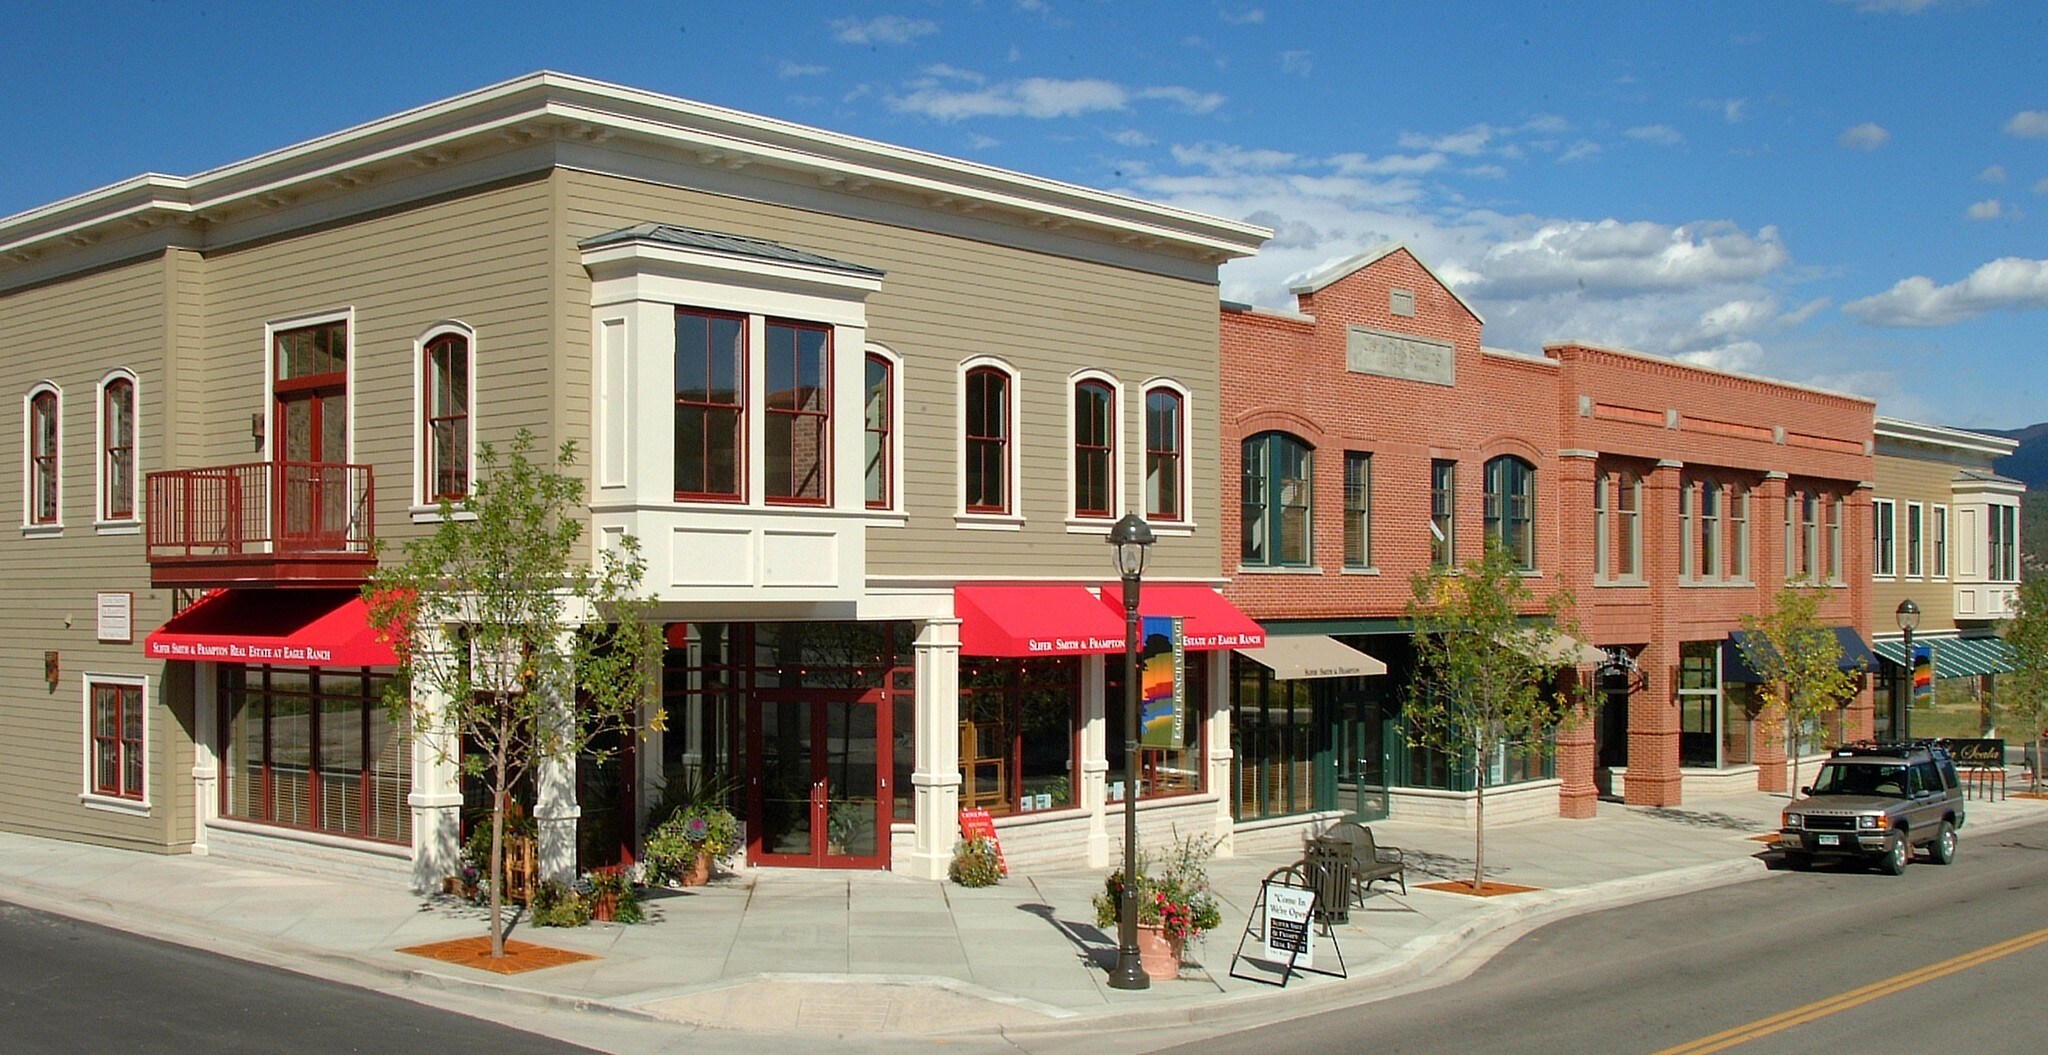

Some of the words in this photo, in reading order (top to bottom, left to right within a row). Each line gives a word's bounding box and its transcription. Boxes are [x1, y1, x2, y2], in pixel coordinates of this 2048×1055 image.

[197, 643, 228, 656] FRAMPTON
[230, 644, 247, 657] REAL
[248, 645, 272, 658] ESTATE
[283, 646, 305, 659] EAGLE
[306, 646, 331, 660] RANCH
[1056, 638, 1079, 650] SMITH
[1081, 640, 1087, 649] &
[1089, 637, 1126, 649] FRAMPTON
[1174, 621, 1182, 664] VILLAGE
[1182, 635, 1206, 647] ESTATE
[1208, 636, 1216, 646] AT
[1217, 634, 1238, 645] EAGLE
[1239, 633, 1261, 645] RANCH
[1174, 667, 1182, 702] RANCH
[1174, 708, 1182, 739] EAGLE
